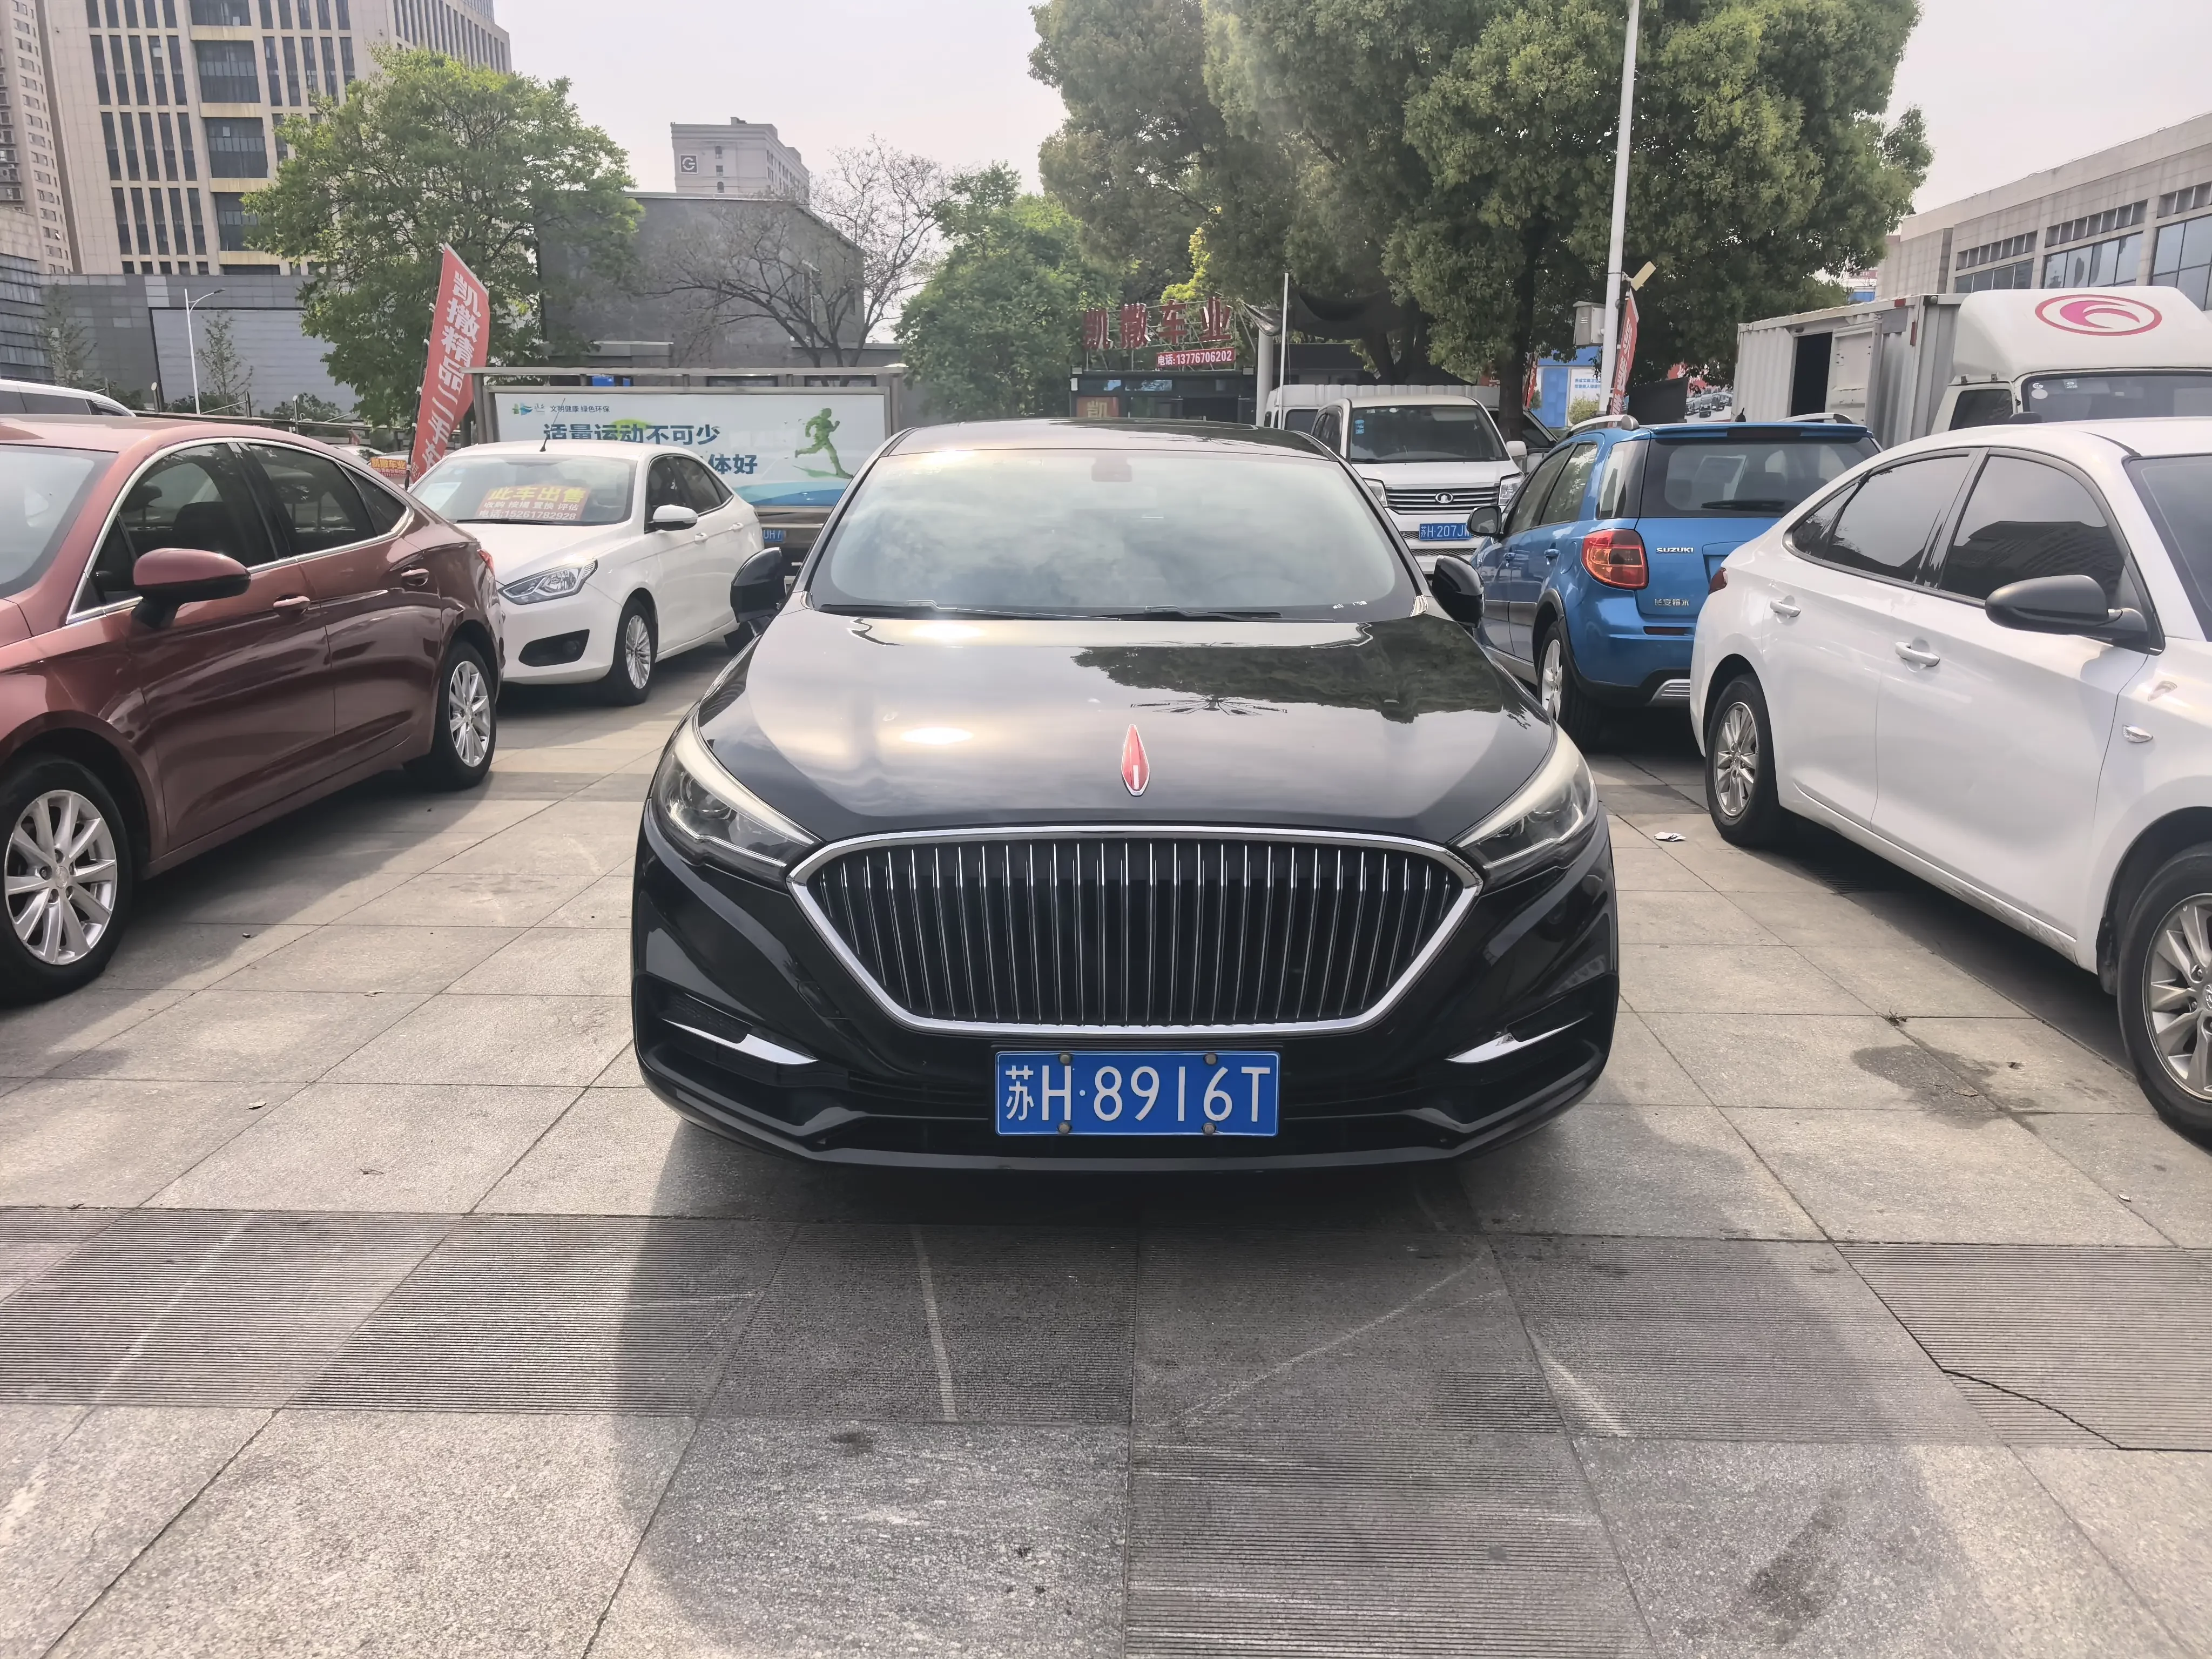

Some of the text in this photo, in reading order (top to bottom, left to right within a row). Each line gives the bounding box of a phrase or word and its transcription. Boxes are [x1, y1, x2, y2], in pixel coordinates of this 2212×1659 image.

[1157, 350, 1232, 366] 电话:13776706202
[544, 423, 721, 445] 适量运动不可少
[700, 453, 758, 474] 体好
[488, 486, 586, 503] 此车出售
[532, 501, 554, 510] 置换
[557, 503, 579, 511] 评估
[1005, 1065, 1271, 1122] 苏H·8916T
